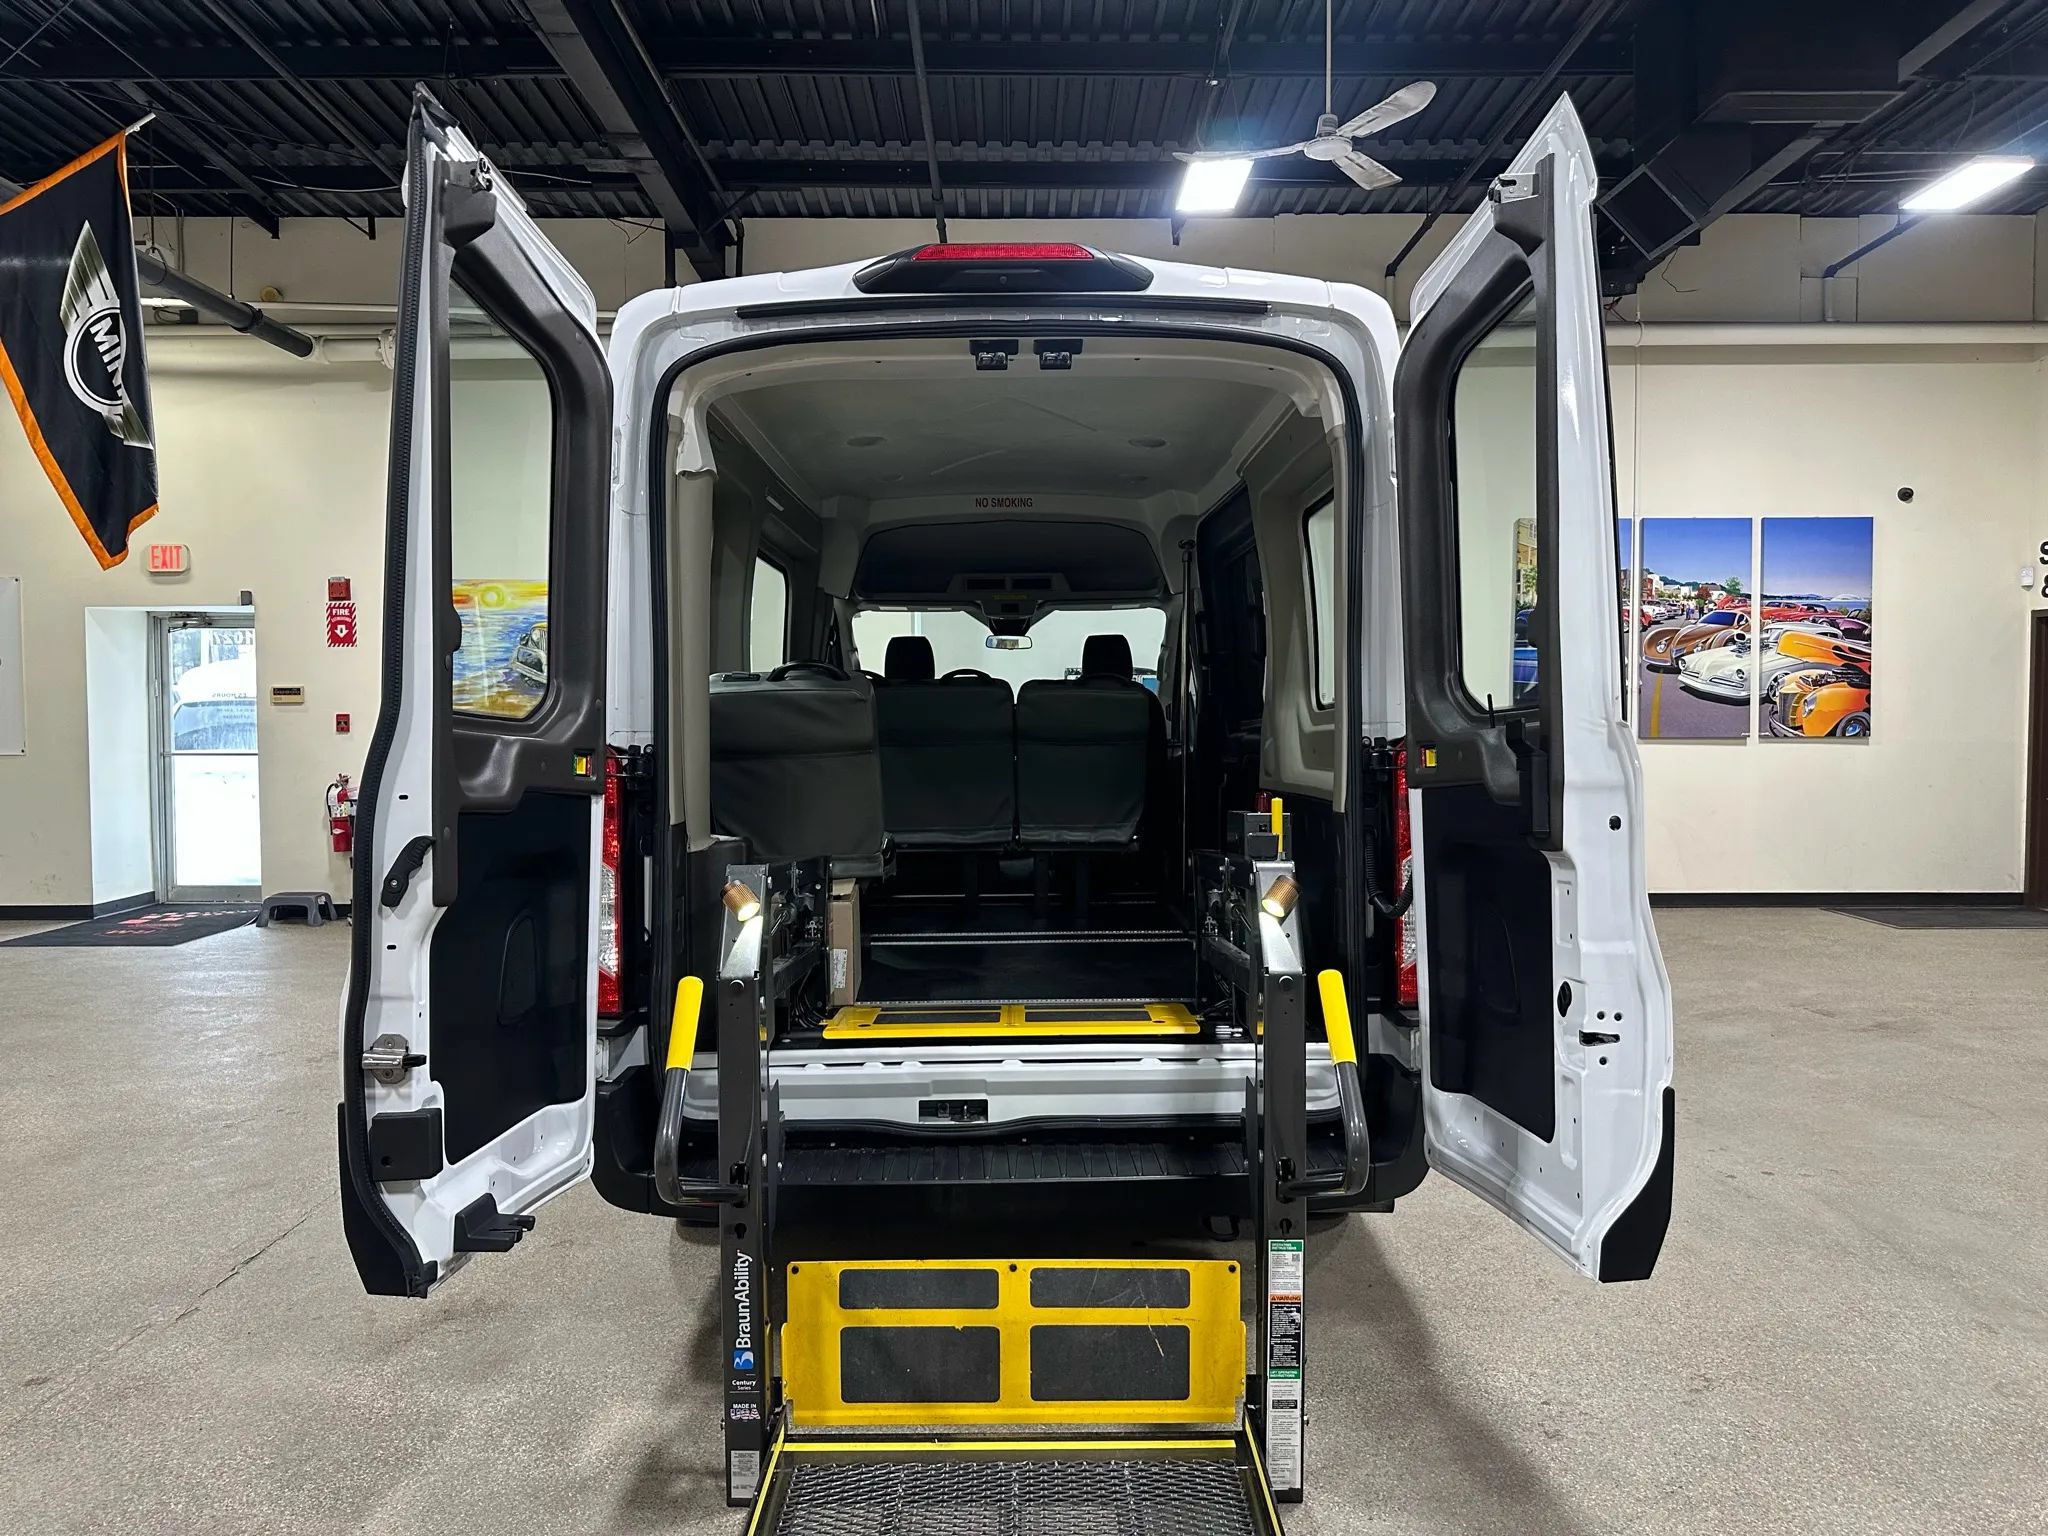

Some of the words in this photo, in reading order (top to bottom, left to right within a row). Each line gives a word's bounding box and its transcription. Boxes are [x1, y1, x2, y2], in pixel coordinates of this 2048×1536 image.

[975, 497, 988, 508] NO
[991, 497, 1033, 508] SMOKING
[150, 545, 182, 569] EXIT
[332, 608, 350, 616] FIRE
[733, 1253, 753, 1348] BraunAbility
[732, 1379, 756, 1387] Century
